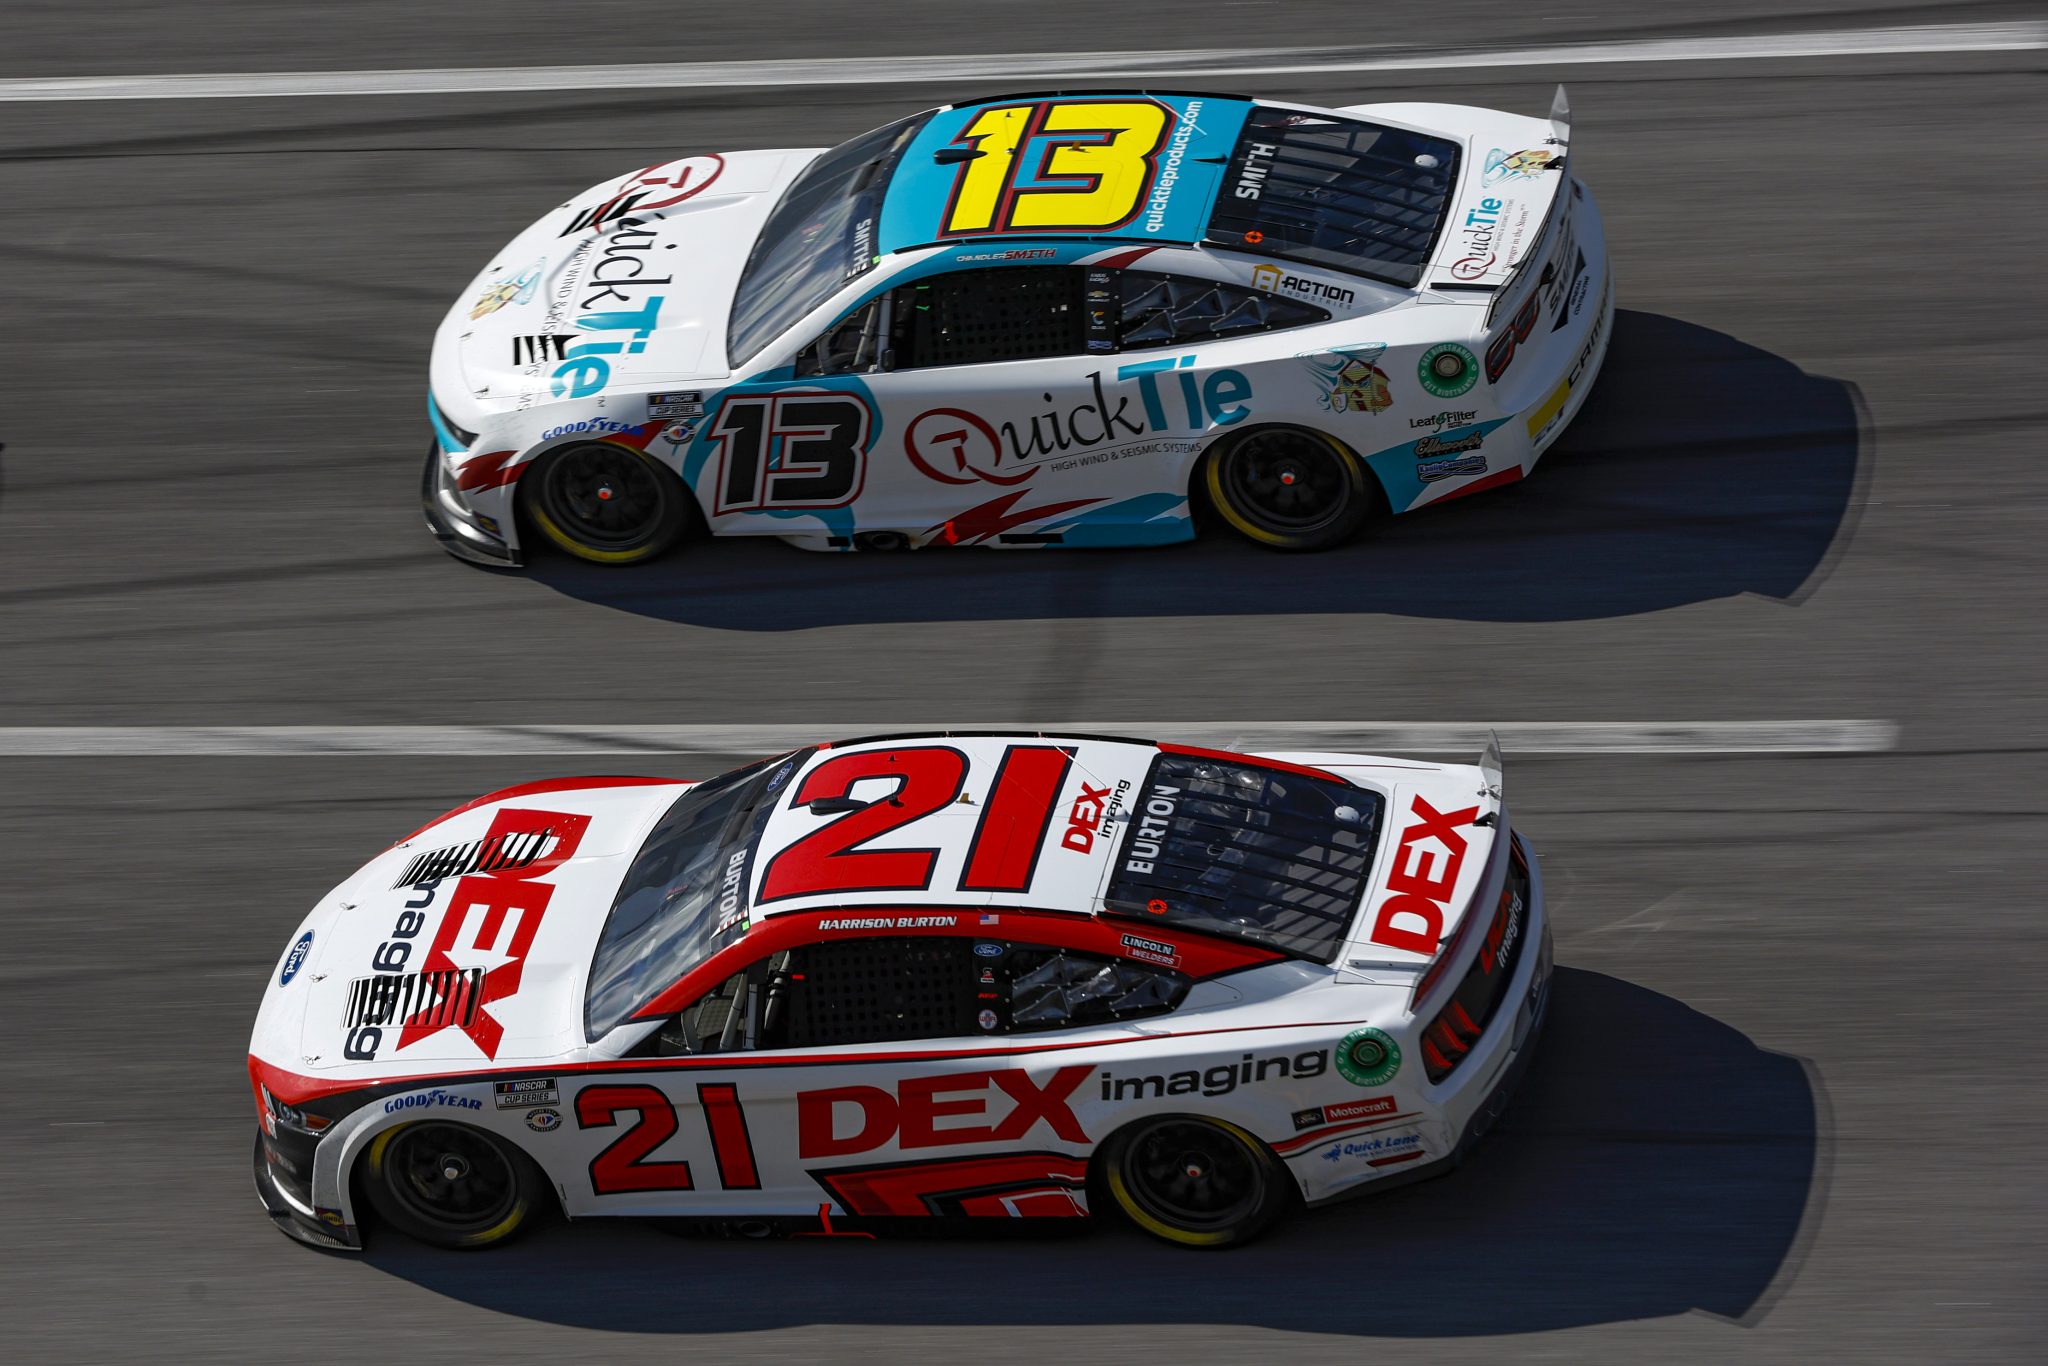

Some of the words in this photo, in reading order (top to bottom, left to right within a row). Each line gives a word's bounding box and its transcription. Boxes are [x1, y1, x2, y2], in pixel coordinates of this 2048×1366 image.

[936, 98, 1177, 240] 13
[1145, 101, 1203, 233] quicktieproducts.com
[852, 218, 872, 268] SMITH
[1005, 248, 1058, 261] SMITH
[1451, 196, 1503, 280] QuickTie
[1281, 275, 1355, 304] ACTION
[542, 417, 647, 441] GOODYEAR
[903, 353, 1254, 486] QuickTie
[705, 391, 873, 518] 13
[1050, 461, 1078, 472] HIGH
[1079, 453, 1109, 468] WIND
[1110, 451, 1119, 460] &
[1119, 444, 1162, 459] SEISMIC
[1162, 441, 1203, 454] SYSTEMS
[753, 744, 1080, 907] 21
[1061, 781, 1112, 855] DEX
[1097, 779, 1131, 838] imaging
[1126, 784, 1181, 874] BURTON
[718, 848, 748, 928] BURTON
[1370, 793, 1480, 957] DEX
[395, 808, 593, 1063] DEX
[819, 917, 895, 930] HARRISON
[896, 916, 957, 928] BURTON
[1123, 935, 1173, 955] LINCOLN
[1496, 890, 1523, 969] imaging
[284, 940, 310, 976] Ford
[343, 852, 464, 1062] magg
[1131, 949, 1176, 966] WELDERS
[384, 1090, 483, 1114] GOODYEAR
[504, 1095, 522, 1104] CUP
[521, 1092, 549, 1102] SERIES
[514, 1080, 547, 1092] NASCAR
[1101, 1049, 1328, 1101] imaging
[573, 1082, 762, 1197] 21
[797, 1064, 1098, 1159] DEX
[1329, 1101, 1391, 1119] Motorcraft
[1343, 1140, 1382, 1155] Quick
[1385, 1134, 1420, 1148] Lane
